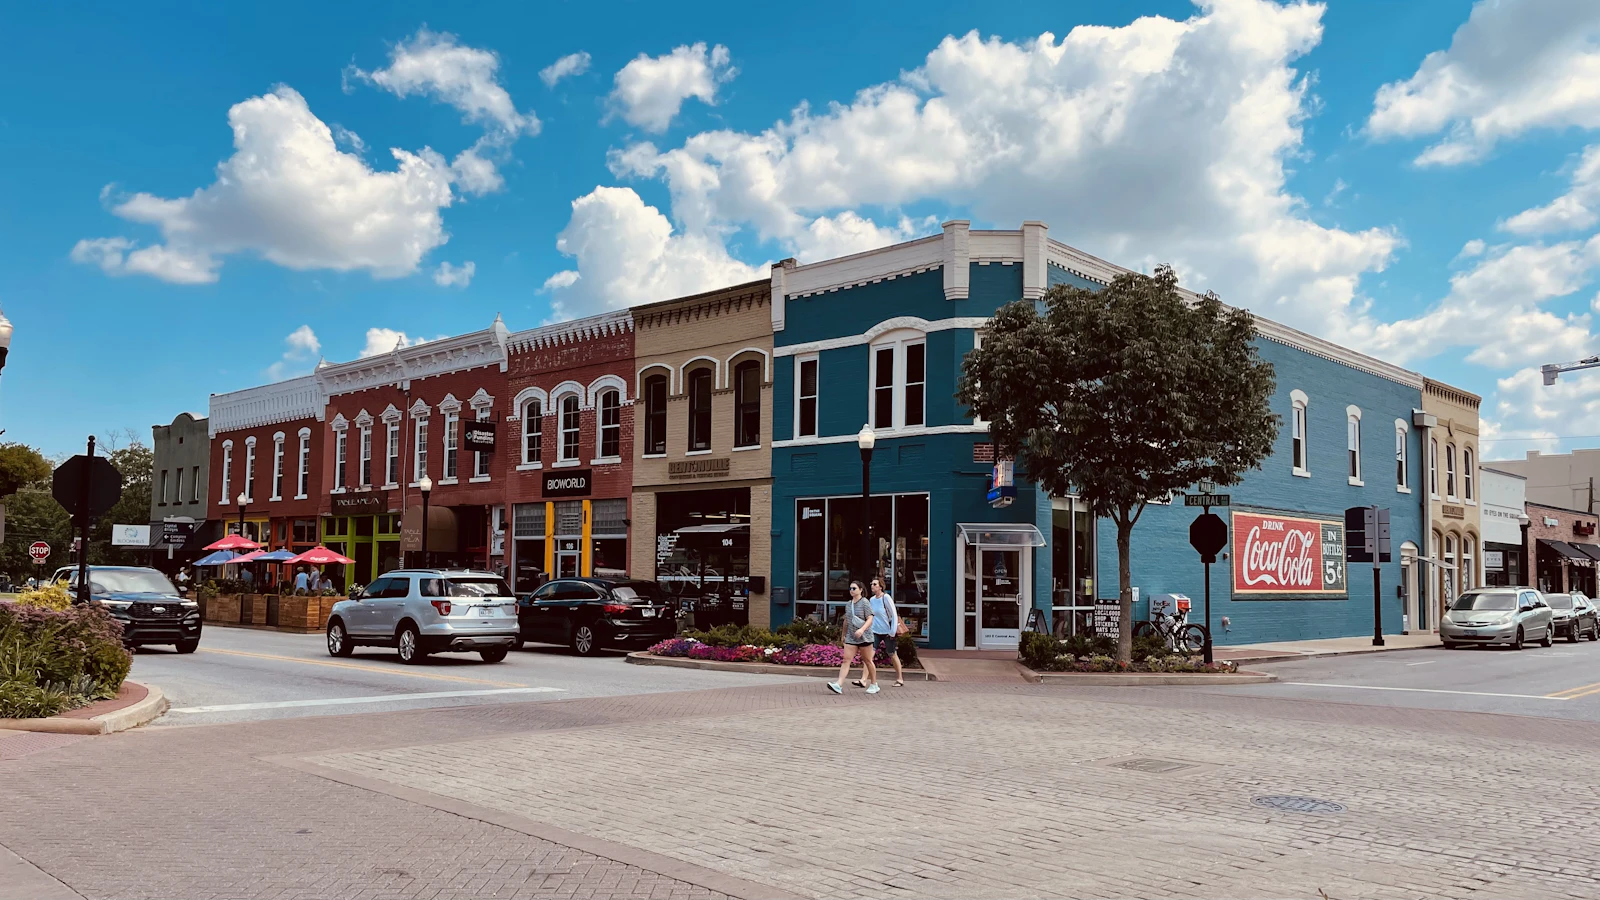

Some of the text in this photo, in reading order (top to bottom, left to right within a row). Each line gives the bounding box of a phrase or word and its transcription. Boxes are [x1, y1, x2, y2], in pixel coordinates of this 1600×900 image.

[668, 458, 730, 474] BENTONVILLE
[547, 477, 586, 490] BIOWORLD
[1190, 495, 1220, 506] CENTRAL
[1262, 520, 1284, 531] DRINK
[1327, 531, 1337, 541] IN
[31, 546, 49, 554] STOP
[1323, 543, 1342, 556] BOTTLES
